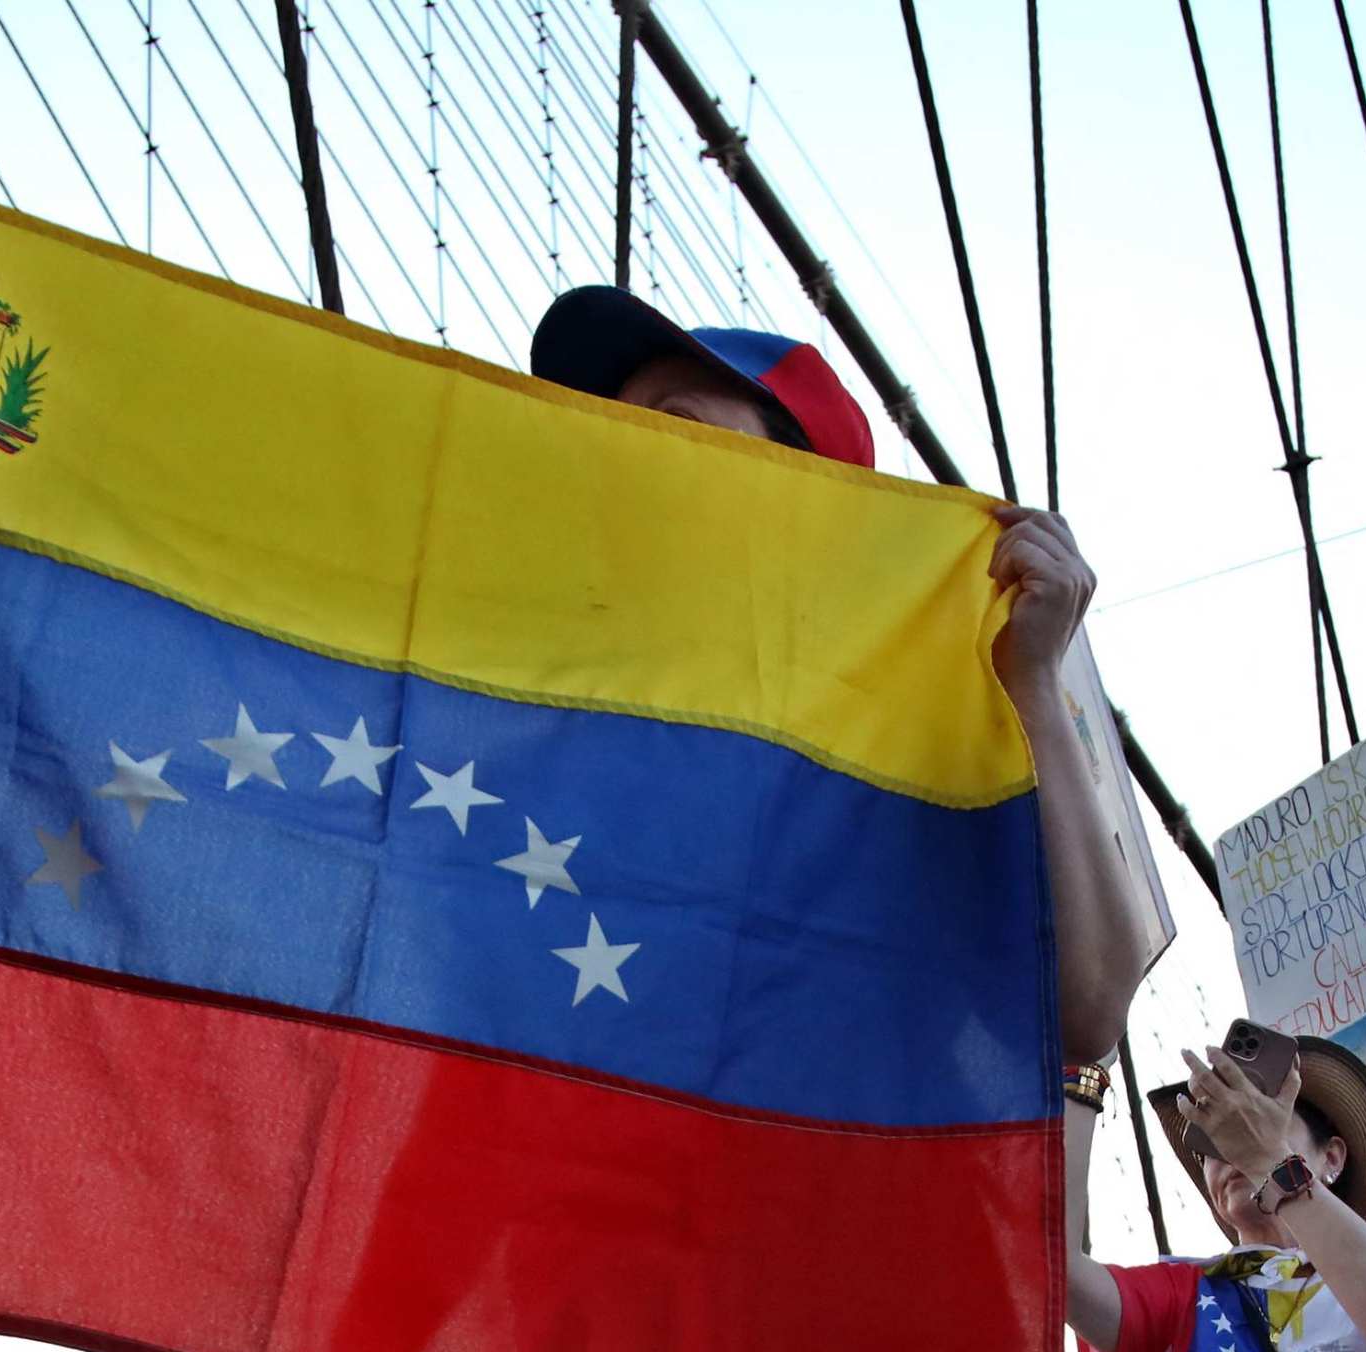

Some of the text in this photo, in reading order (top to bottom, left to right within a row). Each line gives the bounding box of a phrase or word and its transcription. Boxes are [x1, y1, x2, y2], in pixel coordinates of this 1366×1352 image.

[1218, 786, 1312, 874] MADURO
[1315, 763, 1349, 811] IS
[1230, 831, 1303, 906] THOSE
[1241, 880, 1304, 946] SIDE
